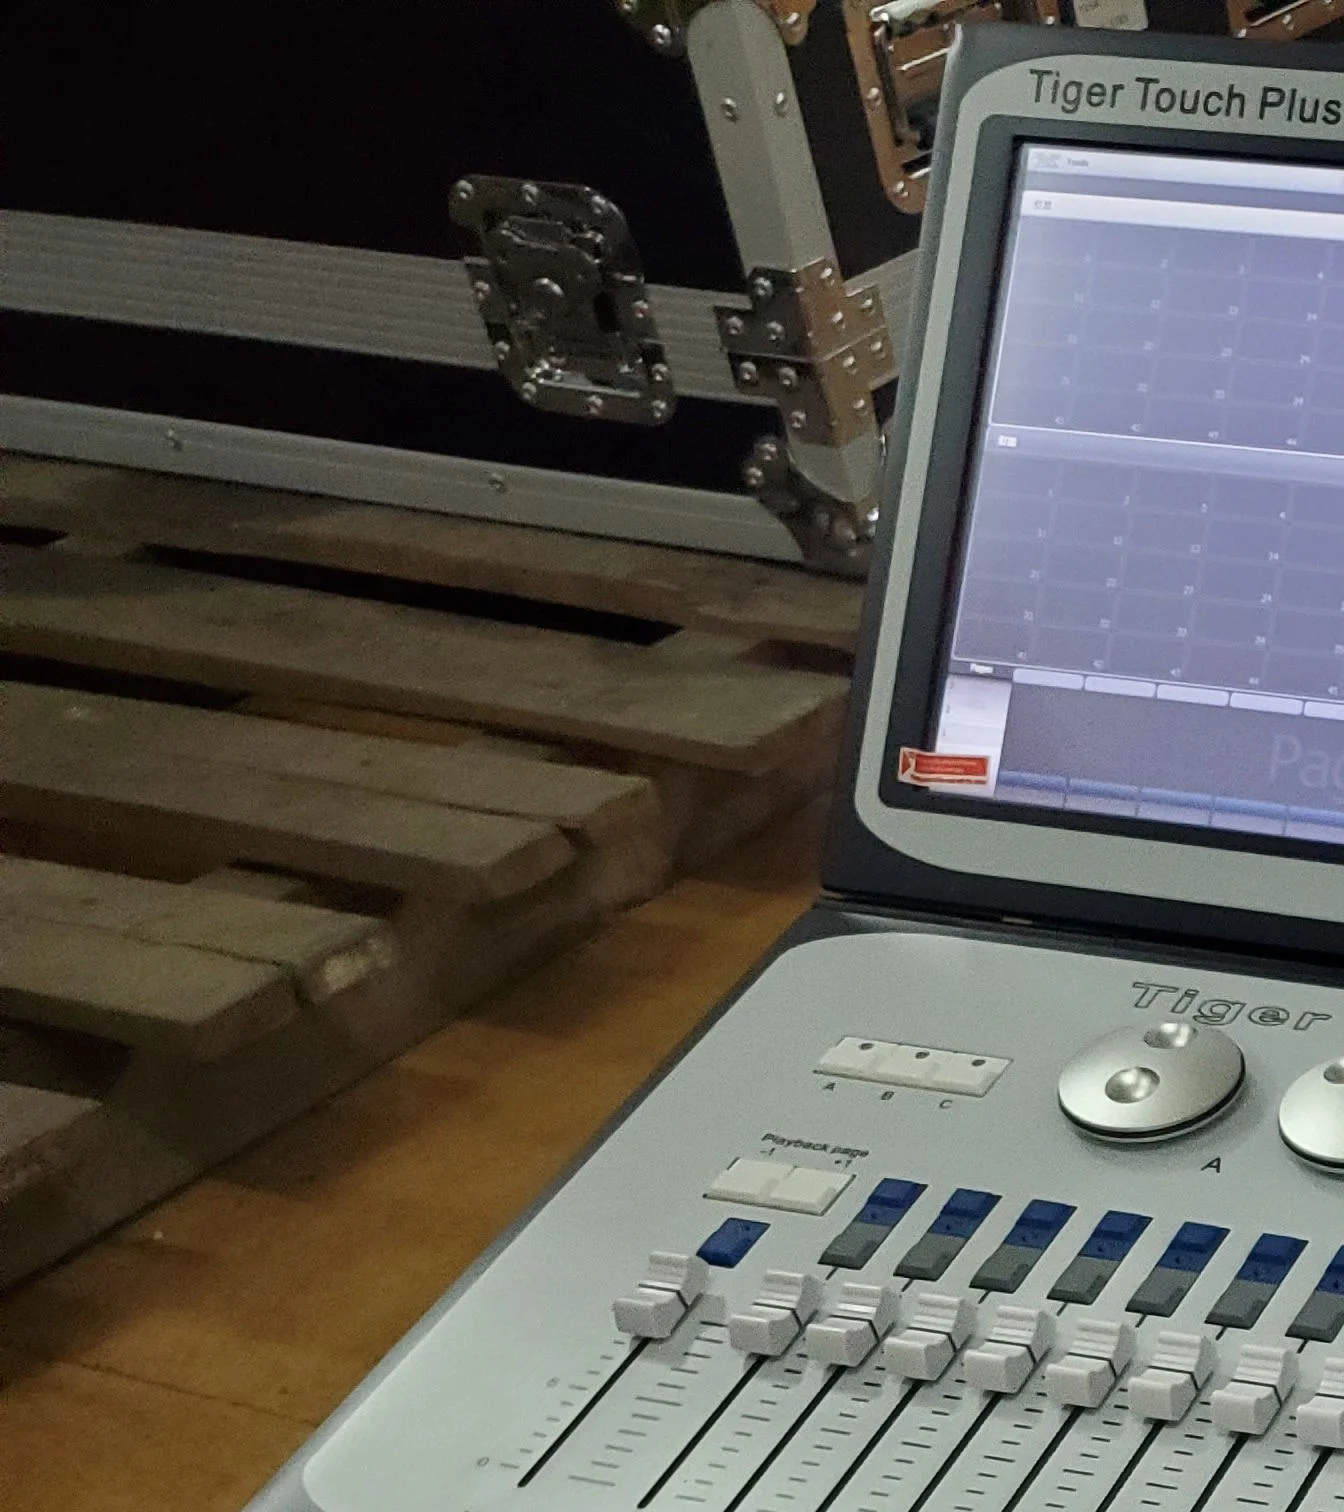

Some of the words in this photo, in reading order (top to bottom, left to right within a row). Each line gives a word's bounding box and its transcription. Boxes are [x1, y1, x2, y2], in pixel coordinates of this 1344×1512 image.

[1030, 69, 1124, 114] Tiger
[1135, 77, 1246, 119] Touch
[1258, 87, 1342, 124] Plus
[1132, 982, 1331, 1030] Tiger
[939, 1100, 952, 1108] C
[762, 1133, 829, 1154] Playback
[826, 1145, 868, 1158] page
[1201, 1158, 1223, 1174] A
